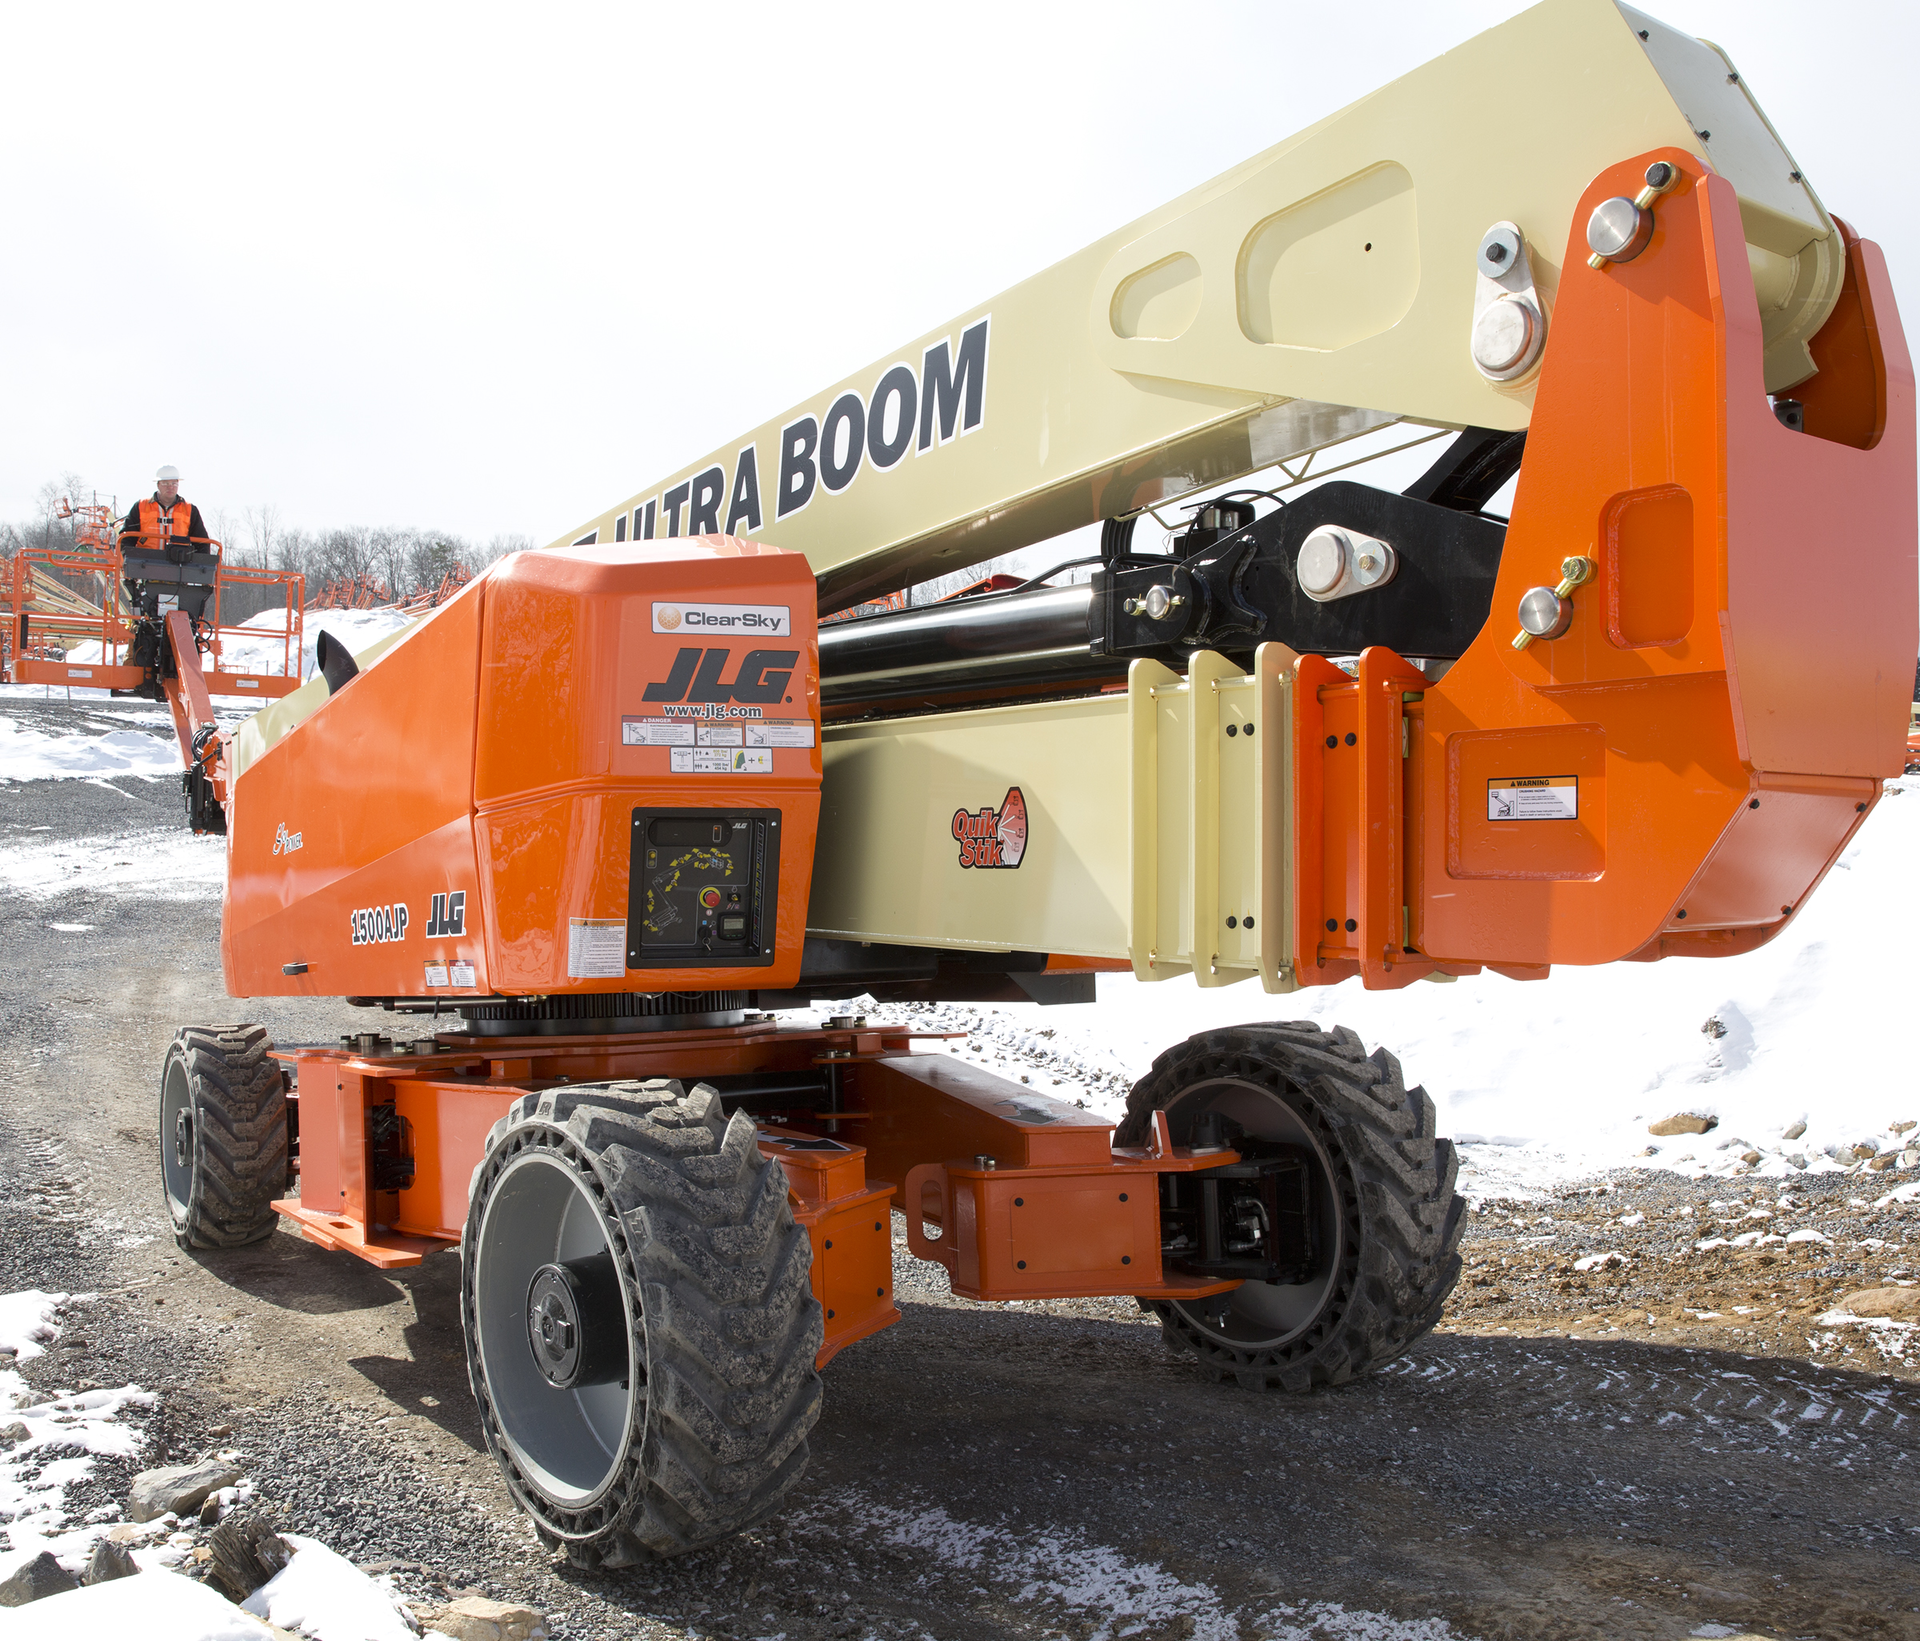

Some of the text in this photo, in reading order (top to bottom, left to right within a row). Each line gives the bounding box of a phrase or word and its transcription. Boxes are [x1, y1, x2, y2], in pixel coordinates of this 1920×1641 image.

[776, 315, 991, 521] BOOM
[684, 611, 781, 631] ClearSky
[641, 648, 800, 703] JLG
[663, 703, 762, 720] www.jlg.com
[1516, 779, 1550, 787] WARNING
[953, 809, 999, 841] Quik
[960, 838, 1003, 866] Stik
[351, 903, 408, 944] 1500AJP
[426, 890, 466, 938] JLG
